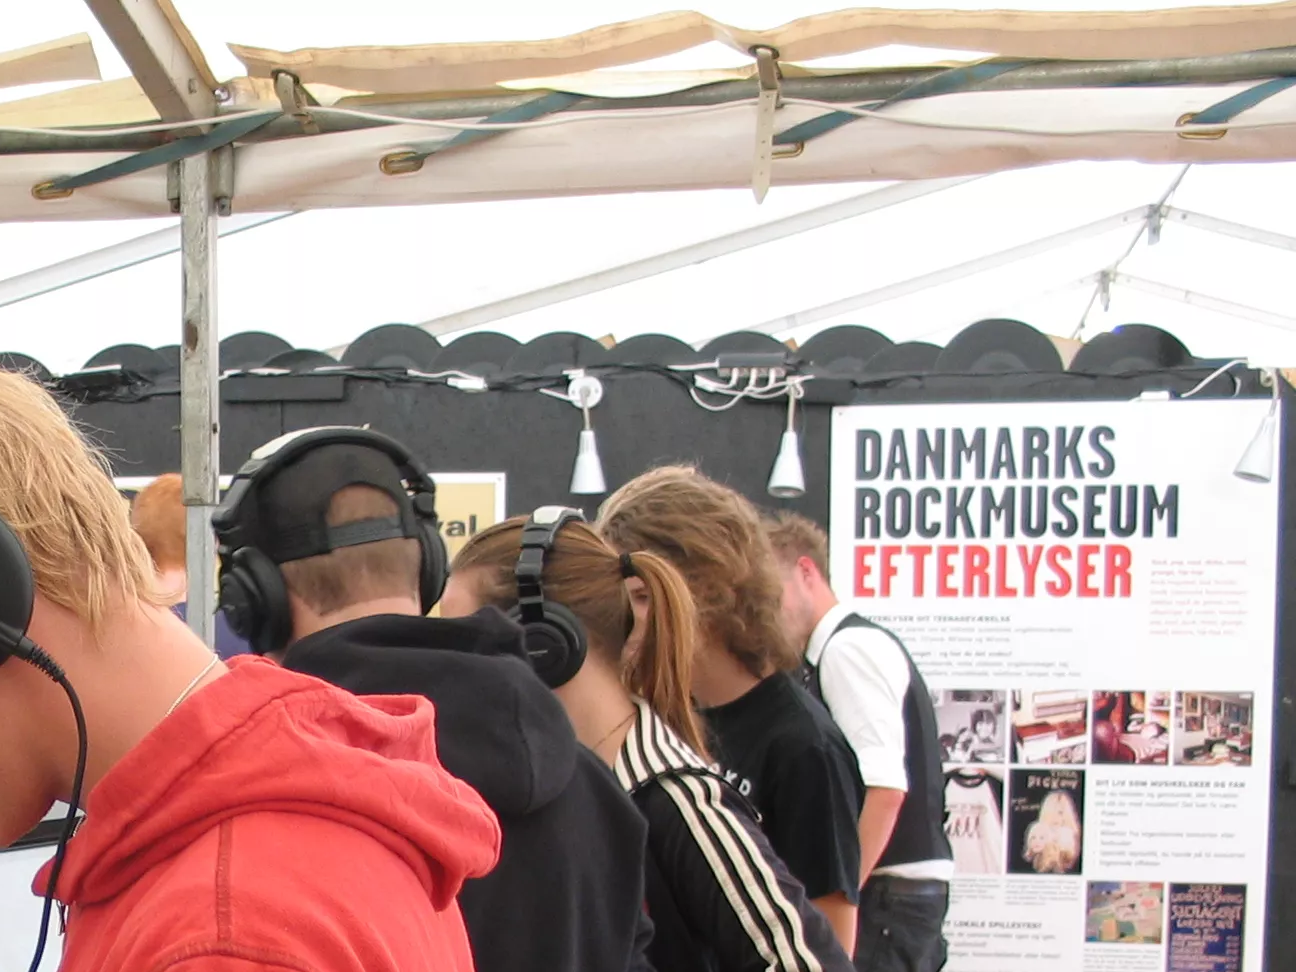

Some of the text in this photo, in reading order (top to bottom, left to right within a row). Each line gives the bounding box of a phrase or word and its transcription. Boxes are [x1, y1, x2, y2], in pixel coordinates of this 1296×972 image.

[855, 426, 1116, 481] DANMARKS
[854, 484, 1179, 539] ROCKMUSEUM
[853, 544, 1132, 598] EFTERLYSER
